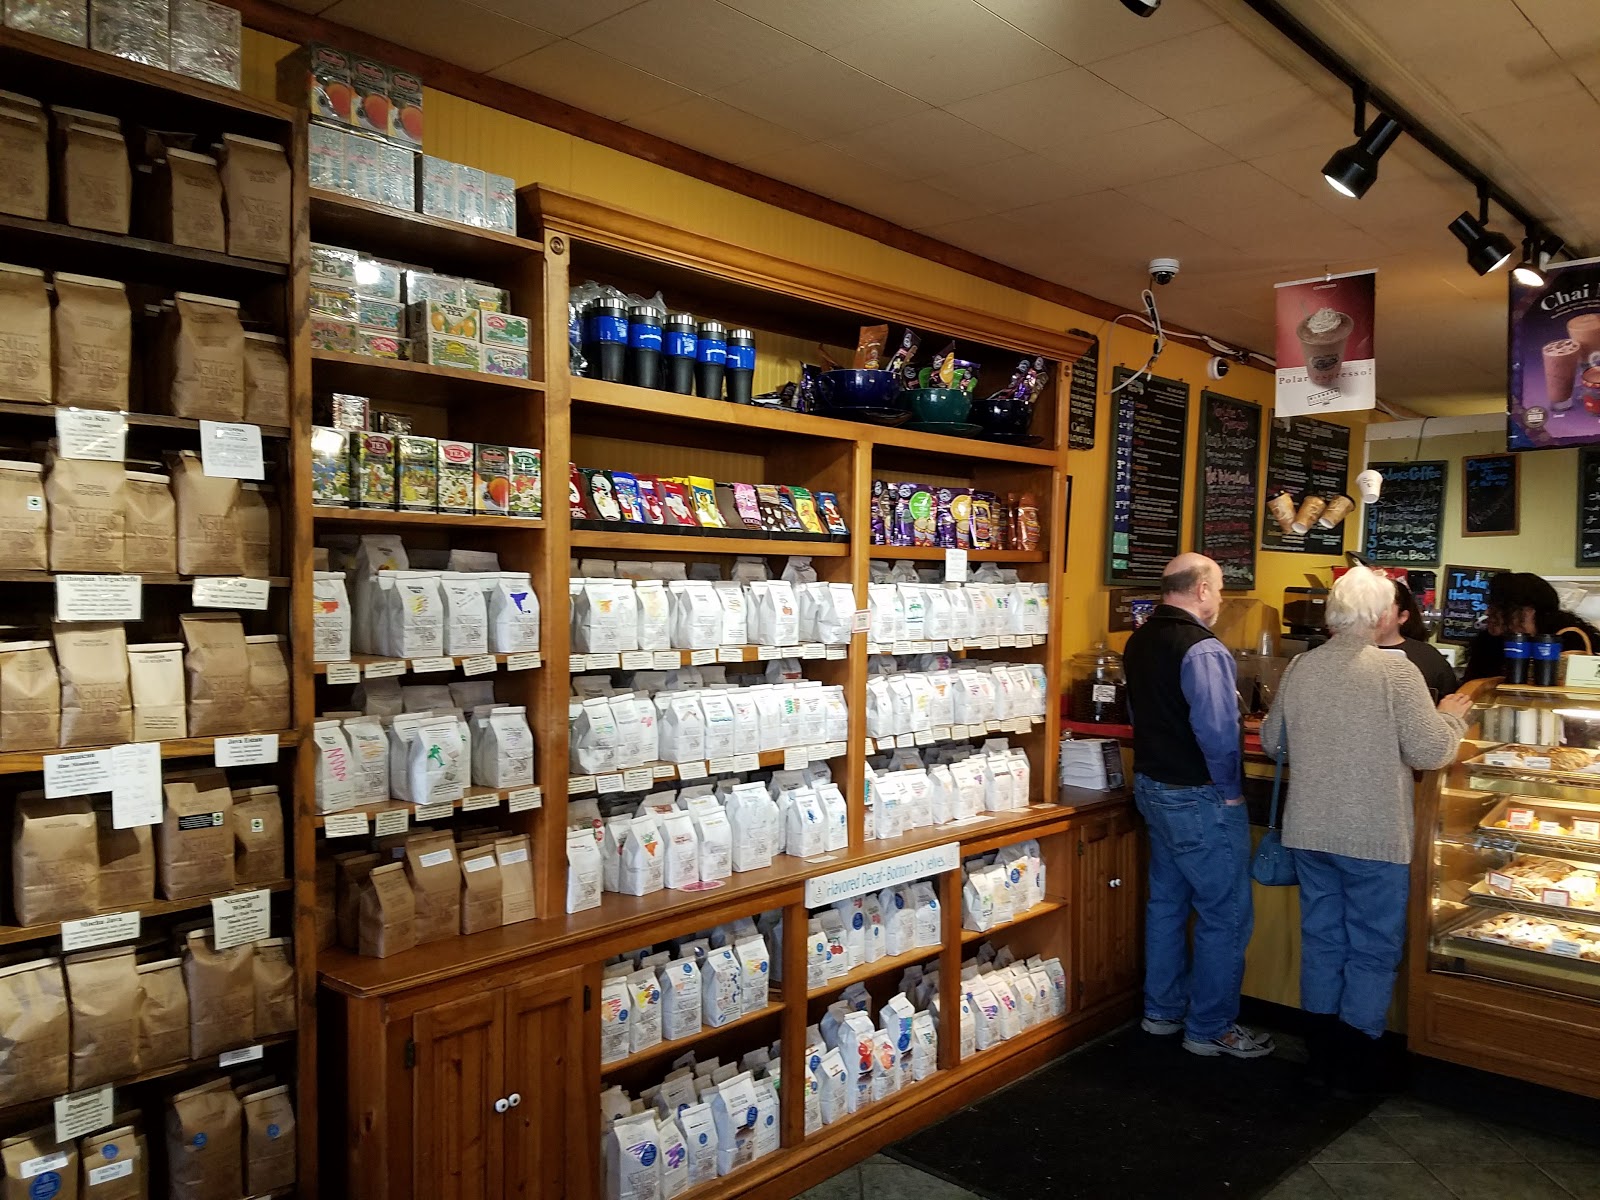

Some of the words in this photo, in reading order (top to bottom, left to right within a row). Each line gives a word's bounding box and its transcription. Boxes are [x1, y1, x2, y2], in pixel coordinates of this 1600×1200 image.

[1540, 283, 1590, 311] Chai
[440, 304, 467, 313] MANGO
[446, 310, 464, 318] TEA
[1279, 376, 1309, 385] Polar
[371, 442, 388, 452] TEA
[449, 450, 466, 458] TEA
[518, 457, 534, 465] TEA
[1409, 466, 1441, 480] Coffee
[1369, 509, 1377, 520] 3
[1368, 522, 1377, 534] 4
[1405, 523, 1436, 534] Decaf
[1367, 536, 1377, 548] 5
[1367, 549, 1377, 560] 6
[1452, 571, 1489, 591] Toda
[60, 753, 95, 761] Jamaican
